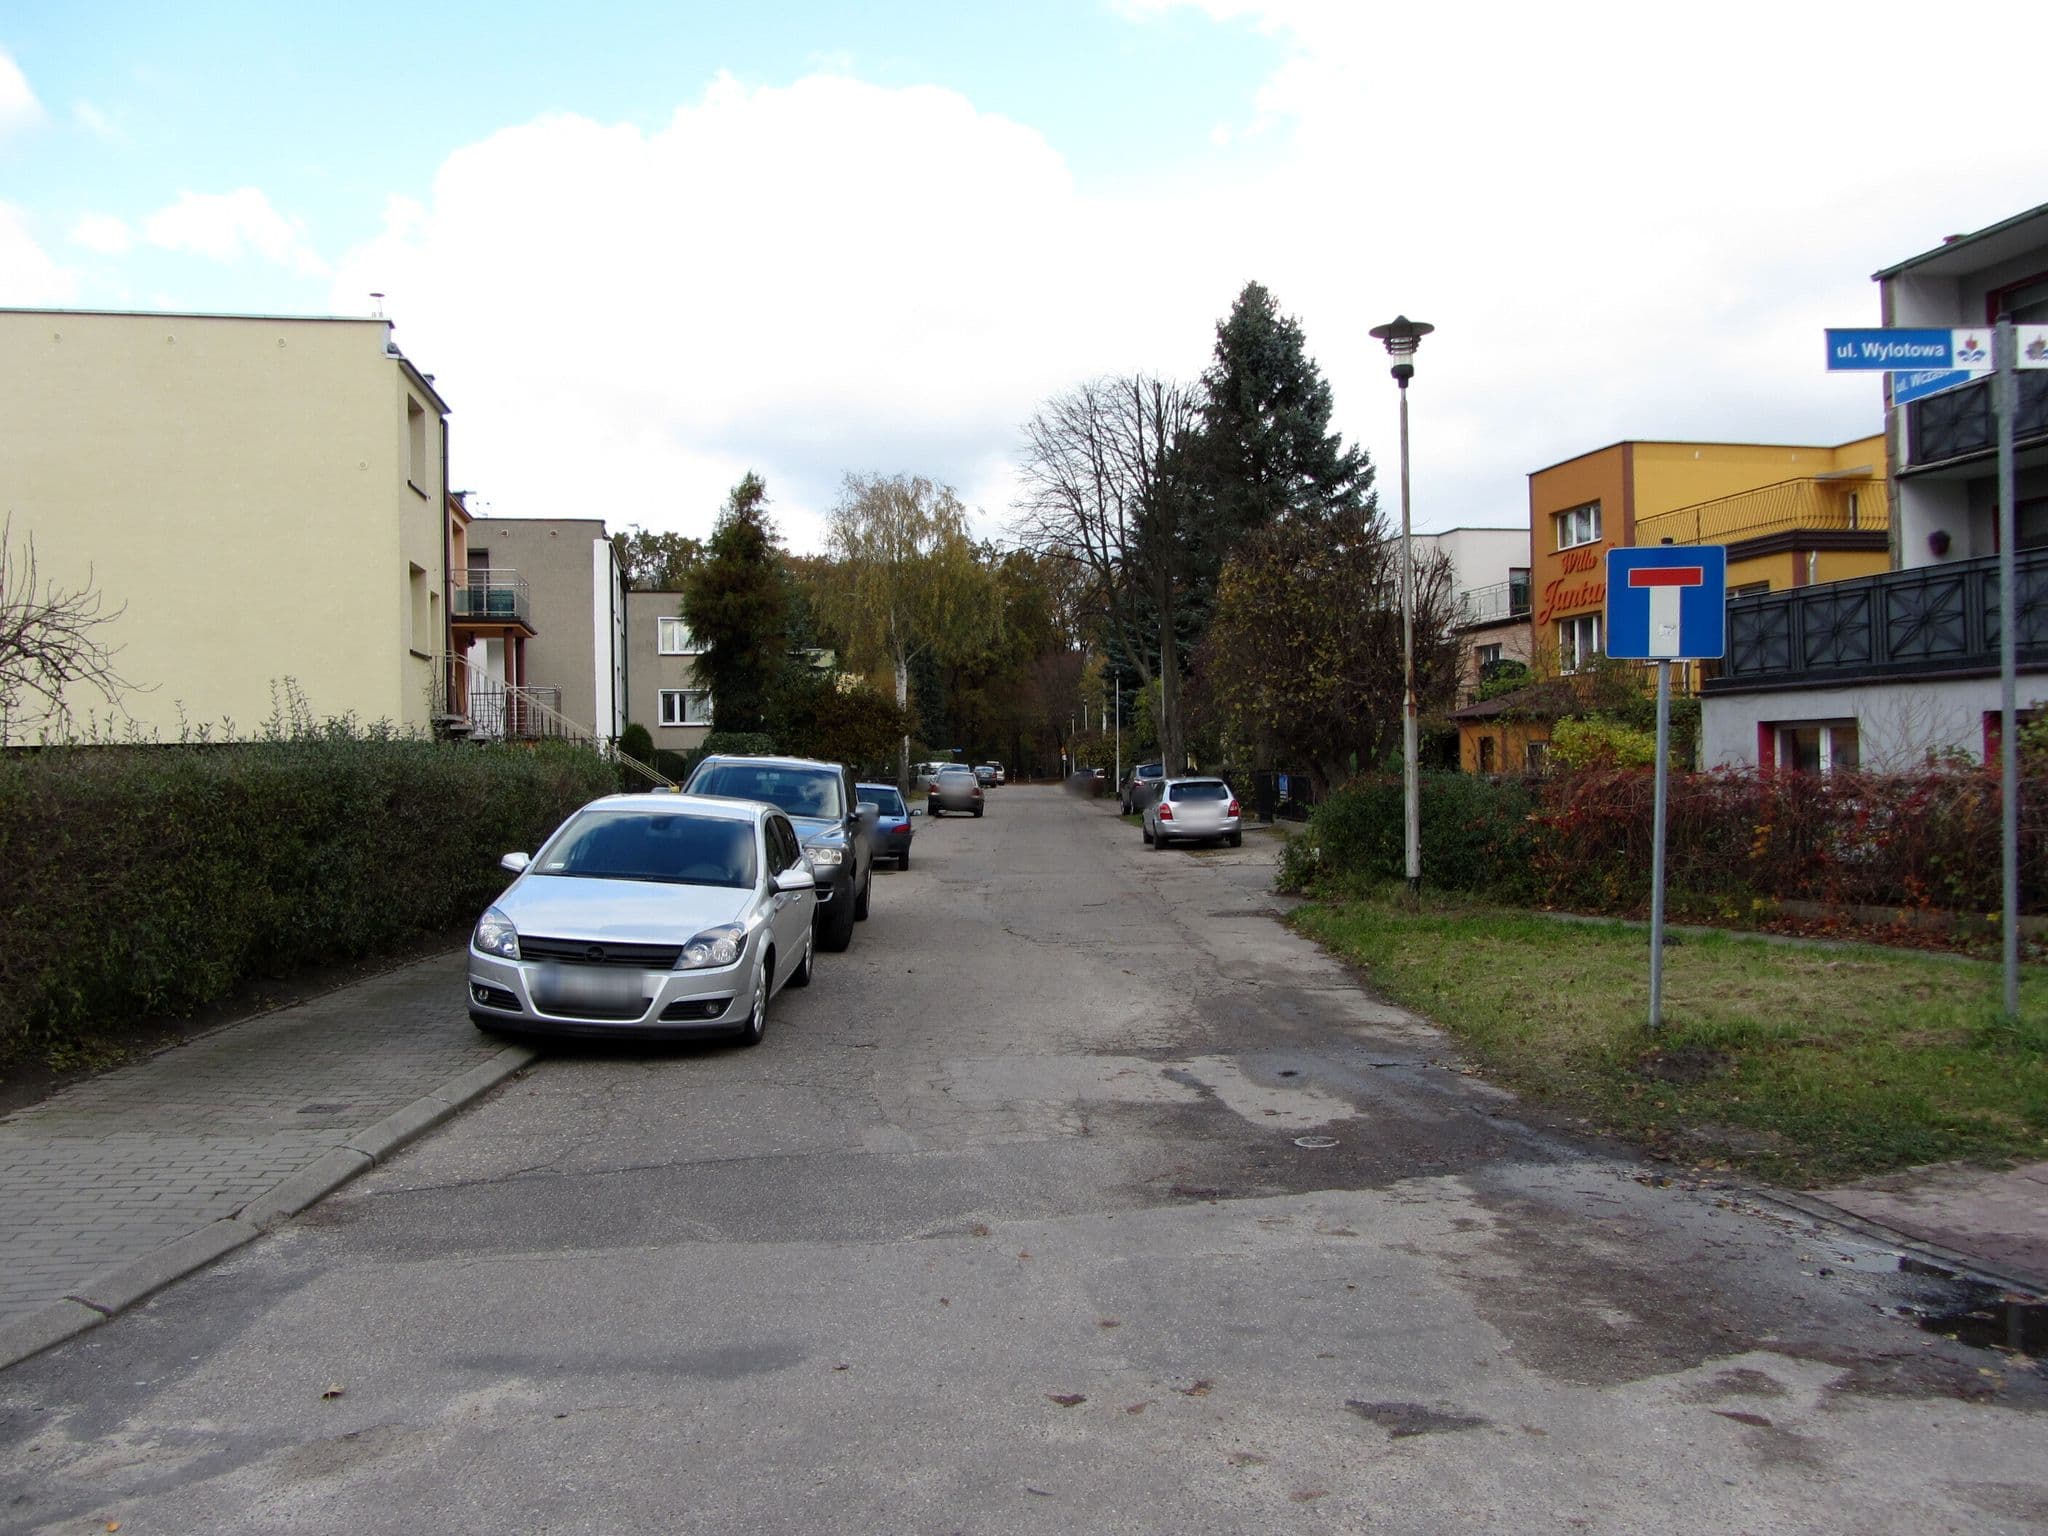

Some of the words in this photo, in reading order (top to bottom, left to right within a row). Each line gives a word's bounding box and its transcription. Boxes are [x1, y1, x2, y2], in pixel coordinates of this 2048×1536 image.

[1837, 342, 1857, 358] ul.
[1862, 342, 1945, 361] Wylotowa
[1562, 550, 1597, 575] Willa
